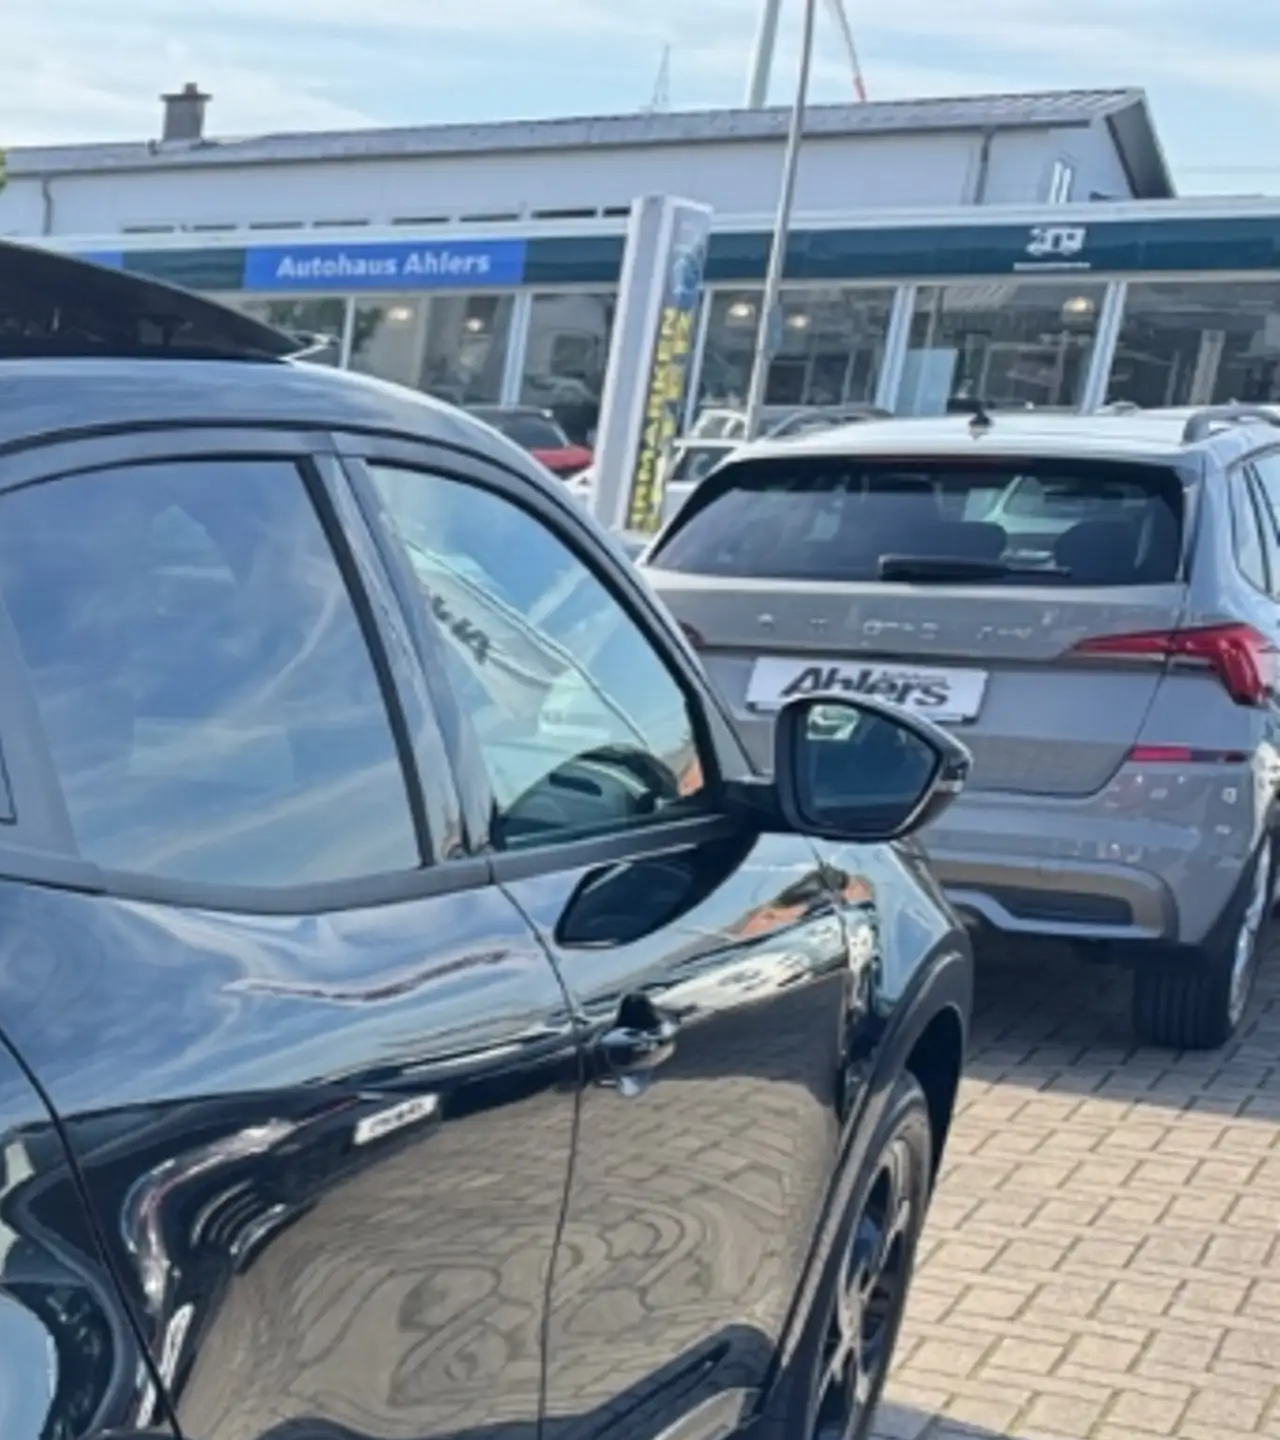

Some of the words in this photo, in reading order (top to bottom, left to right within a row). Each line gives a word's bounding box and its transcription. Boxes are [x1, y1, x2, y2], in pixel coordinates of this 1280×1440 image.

[276, 253, 398, 279] Autohaus
[403, 251, 491, 276] Ahlers
[779, 666, 952, 707] Ahlers
